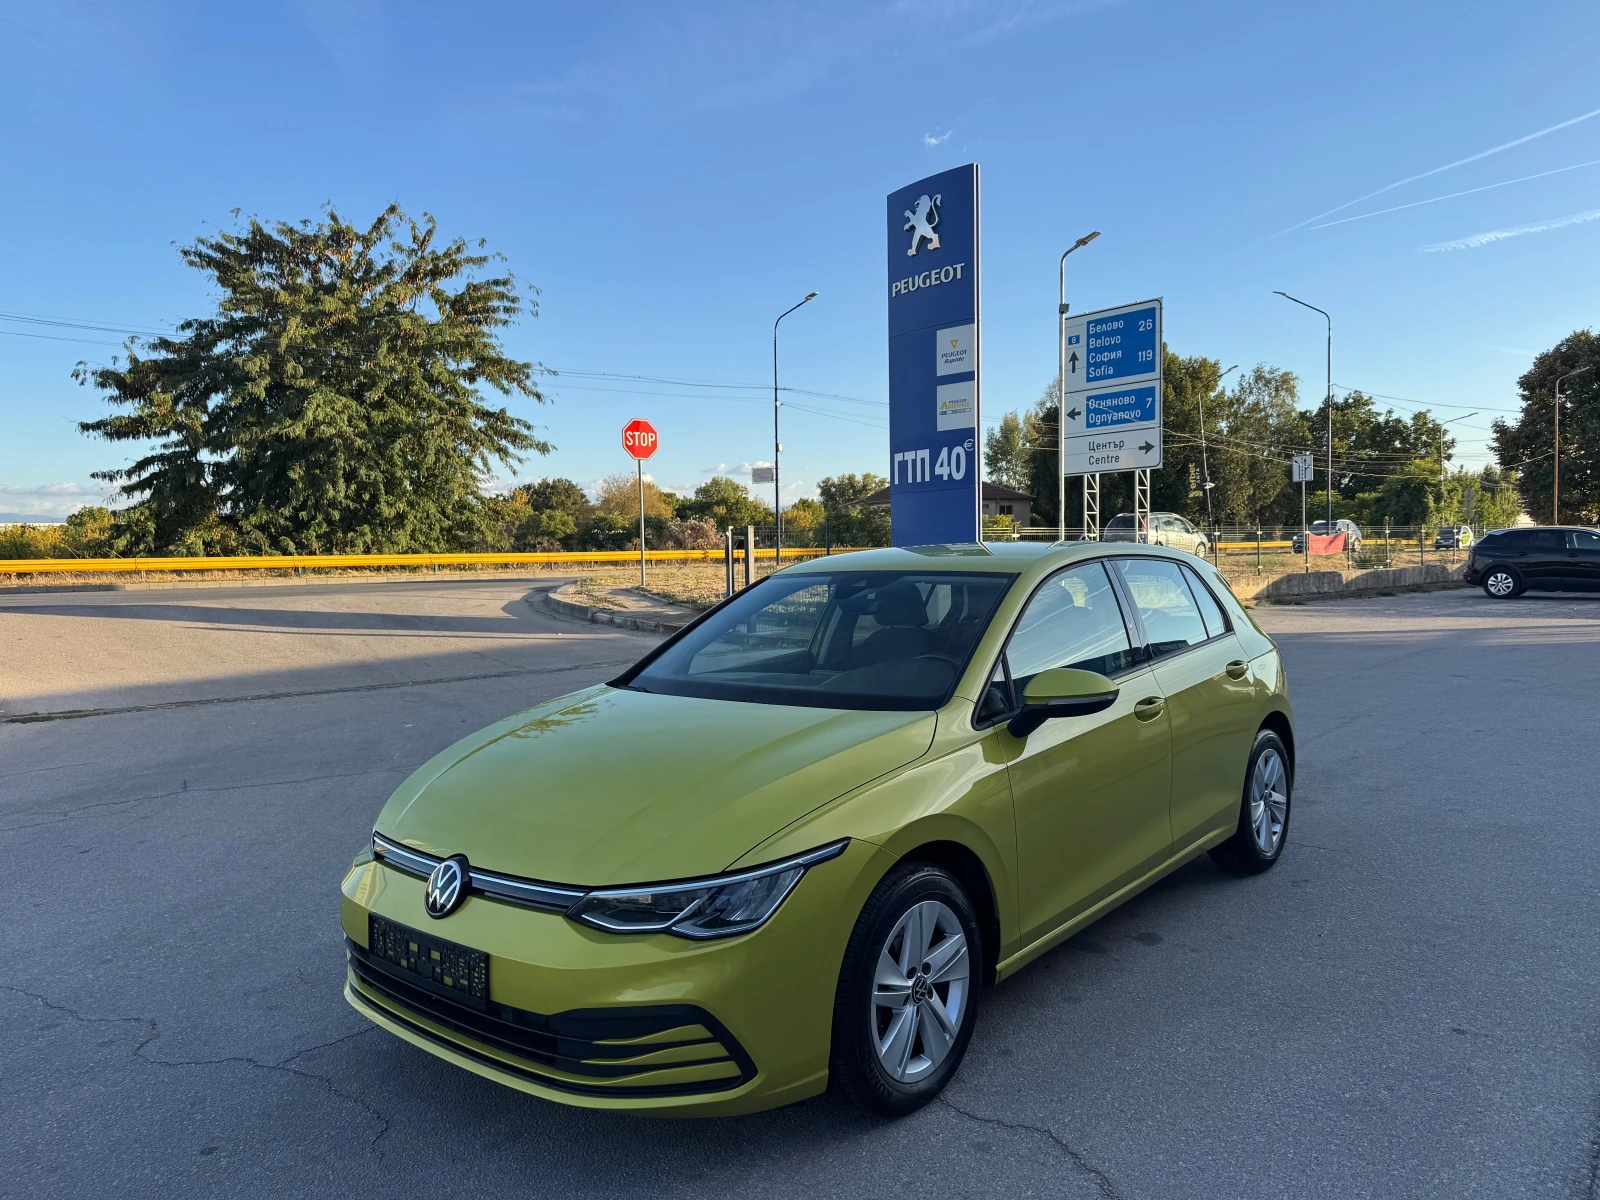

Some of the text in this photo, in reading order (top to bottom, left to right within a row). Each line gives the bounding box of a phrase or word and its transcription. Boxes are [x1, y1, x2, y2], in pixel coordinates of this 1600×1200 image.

[892, 262, 966, 298] PEUGEOT
[1089, 319, 1153, 335] Белово 26
[1071, 336, 1077, 344] 8
[1089, 335, 1121, 349] Belovo
[941, 349, 967, 359] PEUGEOT
[1089, 349, 1153, 363] София 119
[1089, 365, 1114, 378] Sofia
[1089, 395, 1153, 409] Огняново 7
[1089, 409, 1141, 425] Ognyanovo
[626, 431, 656, 447] STOP
[1089, 440, 1125, 452] Център
[893, 448, 930, 485] ГТП
[1089, 454, 1120, 465] Centre
[1189, 462, 1197, 489] efbet
